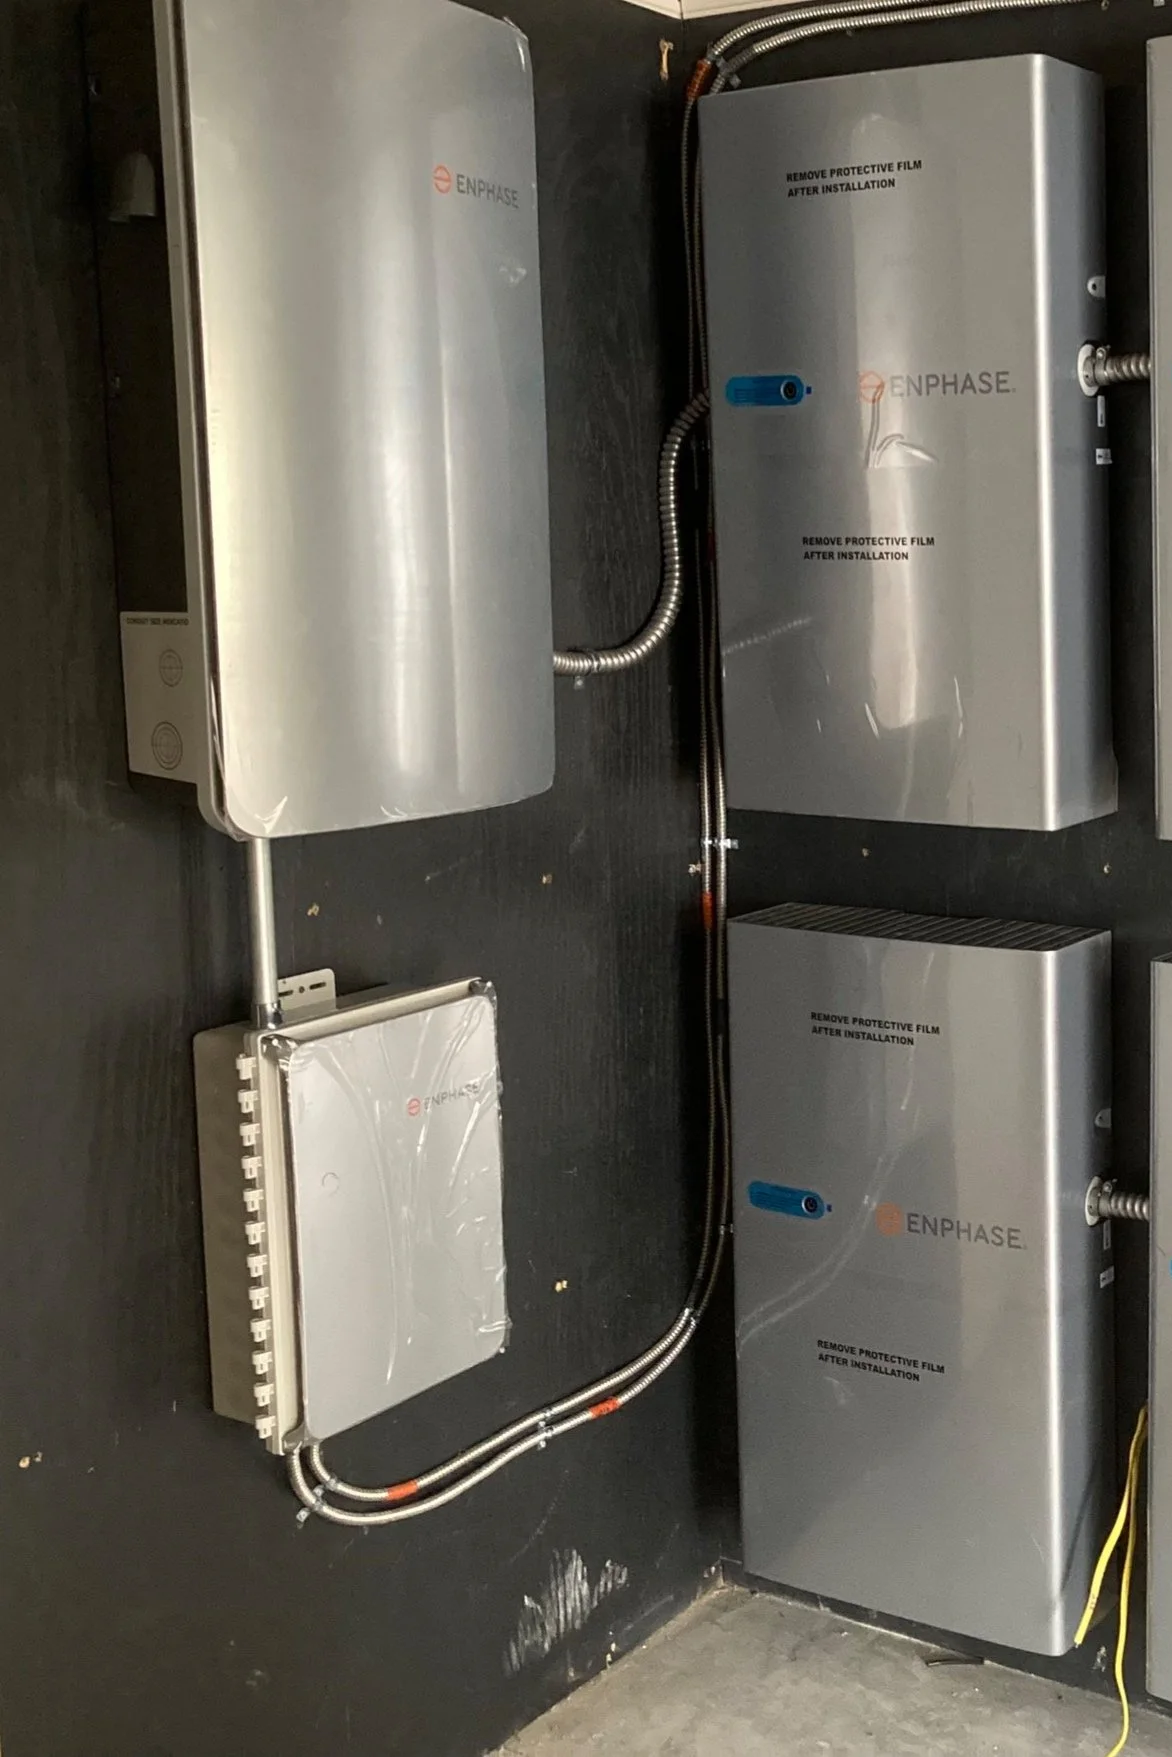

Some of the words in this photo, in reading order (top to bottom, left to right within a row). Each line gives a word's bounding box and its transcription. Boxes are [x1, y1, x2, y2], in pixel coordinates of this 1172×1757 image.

[786, 169, 827, 182] REMOVE
[830, 162, 894, 178] PROTECTIVE
[897, 160, 922, 171] FILM
[457, 174, 519, 209] ENPHASE
[788, 186, 818, 198] AFTER
[822, 178, 895, 194] INSTALLATION
[802, 537, 842, 546] REMOVE
[845, 537, 907, 546] PROTECTIVE
[911, 537, 935, 546] FILM
[803, 552, 834, 560] AFTER
[838, 552, 909, 560] INSTALLATION
[811, 1012, 849, 1024] REMOVE
[852, 1018, 913, 1032] PROTECTIVE
[916, 1024, 940, 1034] FILM
[812, 1026, 841, 1037] AFTER
[844, 1030, 914, 1045] INSTALLATION
[817, 1340, 856, 1355] REMOVE
[859, 1348, 918, 1368] PROTECTIVE
[922, 1362, 945, 1373] FILM
[818, 1354, 848, 1366] AFTER
[851, 1359, 920, 1381] INSTALLATION
